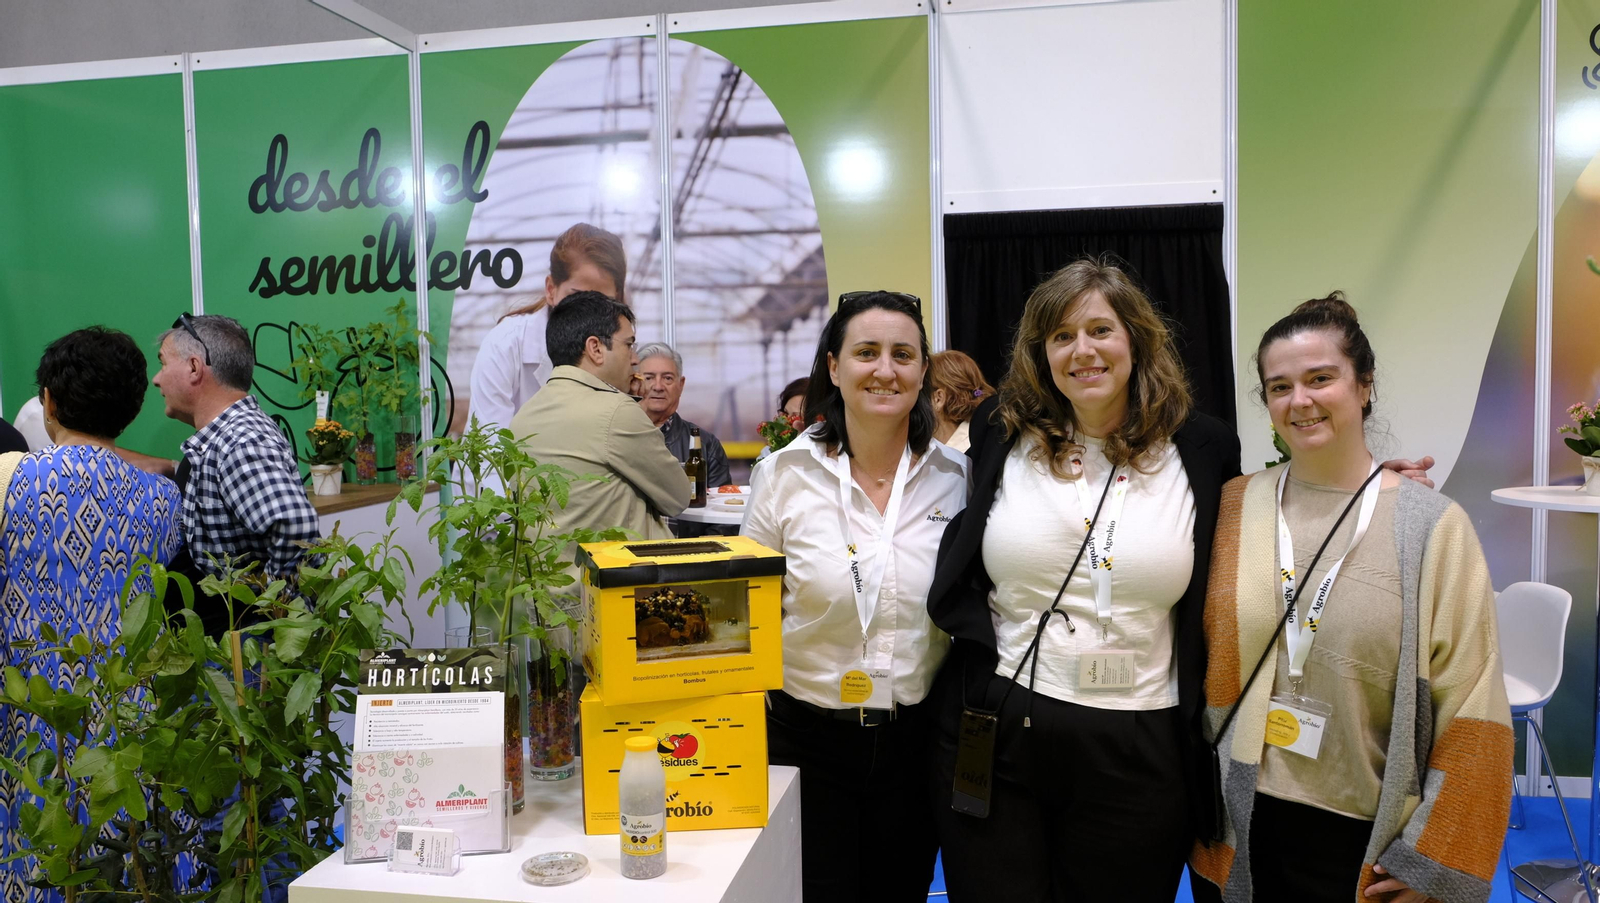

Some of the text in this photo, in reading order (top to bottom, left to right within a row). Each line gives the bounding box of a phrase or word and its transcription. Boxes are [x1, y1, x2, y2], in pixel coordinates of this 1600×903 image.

[248, 120, 490, 214] desde el
[248, 211, 524, 299] semillero
[1103, 520, 1116, 553] Agrobío
[850, 559, 862, 594] Agrobío
[1312, 577, 1332, 614] Agrobío
[367, 663, 493, 687] HORTÍCOLAS
[632, 673, 669, 682] Biopolinización
[701, 668, 719, 676] frutales
[660, 757, 698, 767] esidues
[435, 798, 488, 807] ALMERIPLANT
